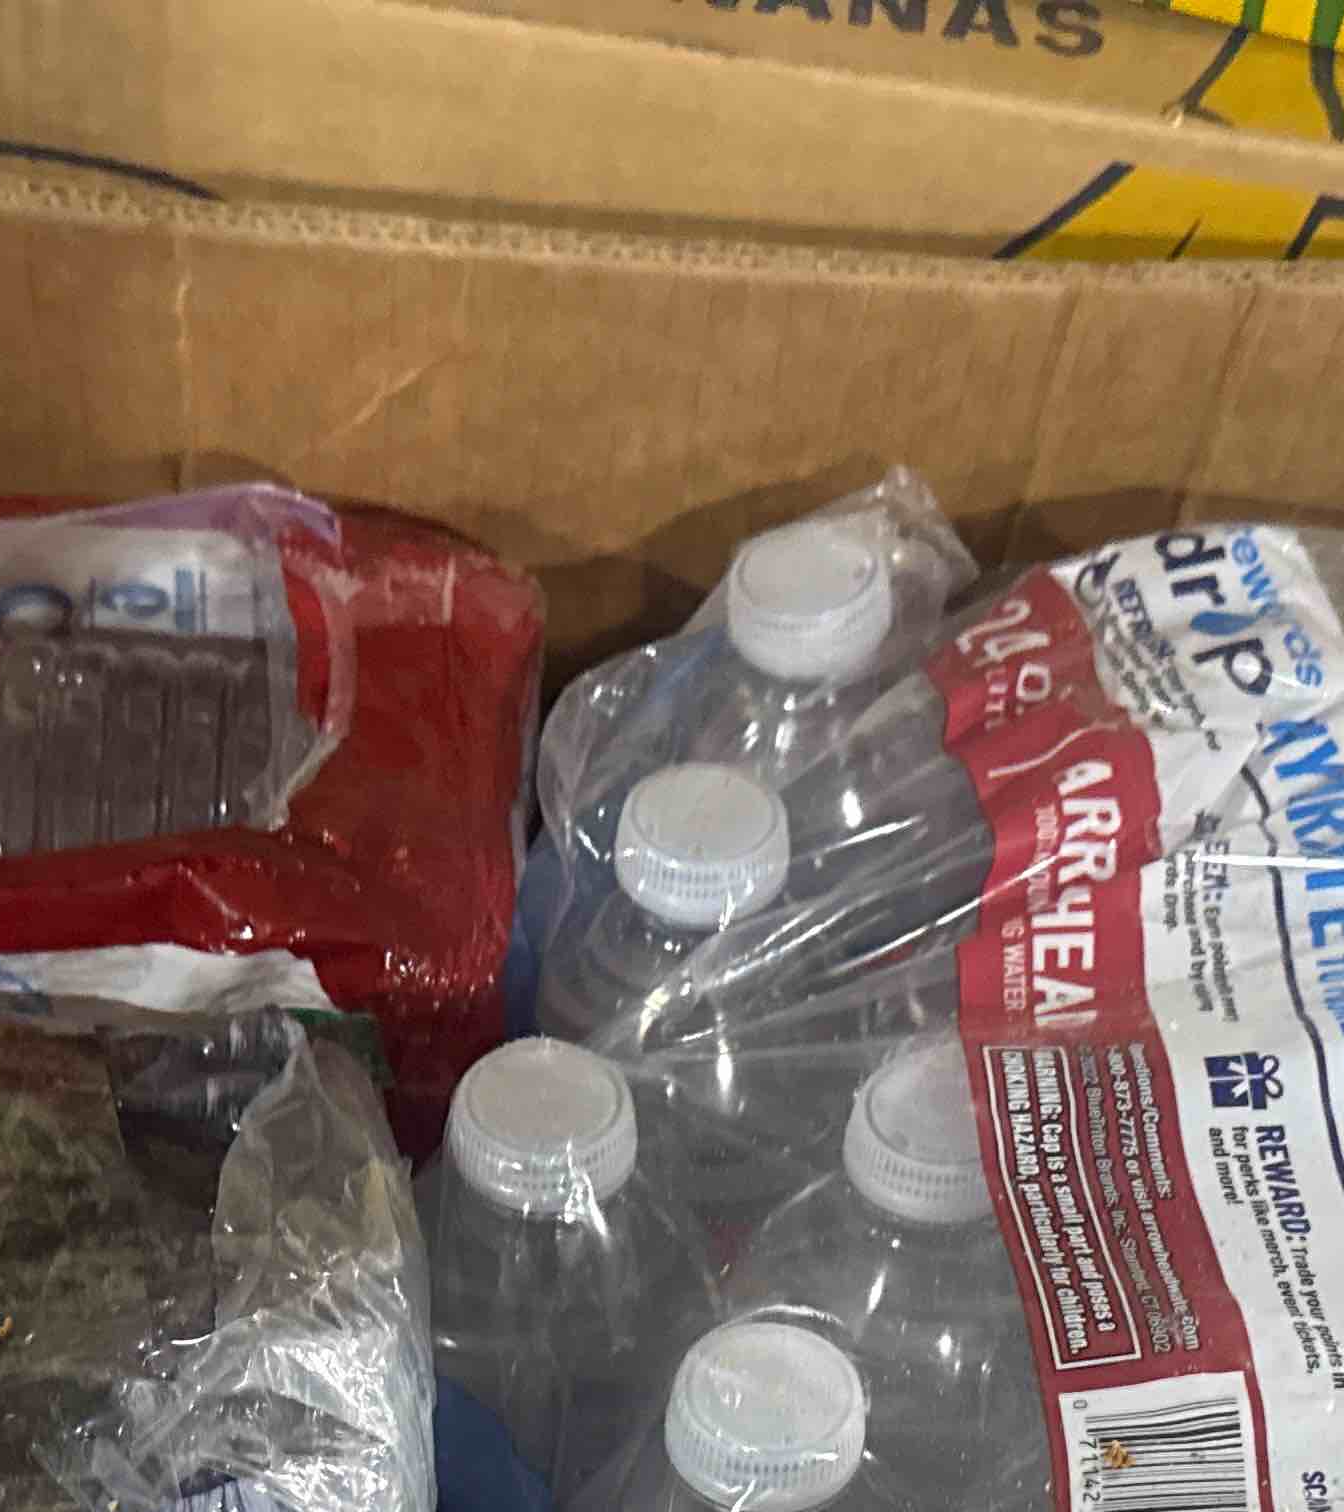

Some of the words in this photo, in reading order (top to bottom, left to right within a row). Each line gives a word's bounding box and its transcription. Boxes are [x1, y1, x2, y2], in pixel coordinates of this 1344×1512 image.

[1189, 928, 1206, 956] and
[1001, 943, 1027, 1010] WATER
[1033, 1050, 1064, 1122] WARNING:
[1010, 1113, 1041, 1181] HAZARD,
[1039, 1123, 1064, 1154] Cap
[1208, 1126, 1230, 1159] and
[1230, 1125, 1251, 1152] for
[1049, 1156, 1067, 1172] is
[1050, 1173, 1066, 1184] a
[1126, 1159, 1142, 1176] or
[1215, 1161, 1242, 1206] more!
[1232, 1153, 1262, 1198] perks
[1256, 1123, 1312, 1243] REWARD:
[1055, 1185, 1083, 1225] small
[1131, 1178, 1151, 1210] visit
[1250, 1199, 1270, 1227] like
[1019, 1182, 1064, 1265] particularly
[1058, 1226, 1094, 1256] part
[1073, 1256, 1101, 1281] and
[1258, 1228, 1290, 1278] merch,
[1290, 1247, 1320, 1287] Trade
[1052, 1266, 1072, 1287] for
[1076, 1280, 1109, 1321] poses
[1276, 1280, 1305, 1319] event
[1292, 1289, 1325, 1322] your
[1055, 1287, 1089, 1355] children.
[1097, 1322, 1116, 1333] a
[1287, 1321, 1323, 1375] tickets,
[1309, 1324, 1342, 1368] points
[1072, 1399, 1088, 1410] 0
[1080, 1438, 1102, 1504] 71142
